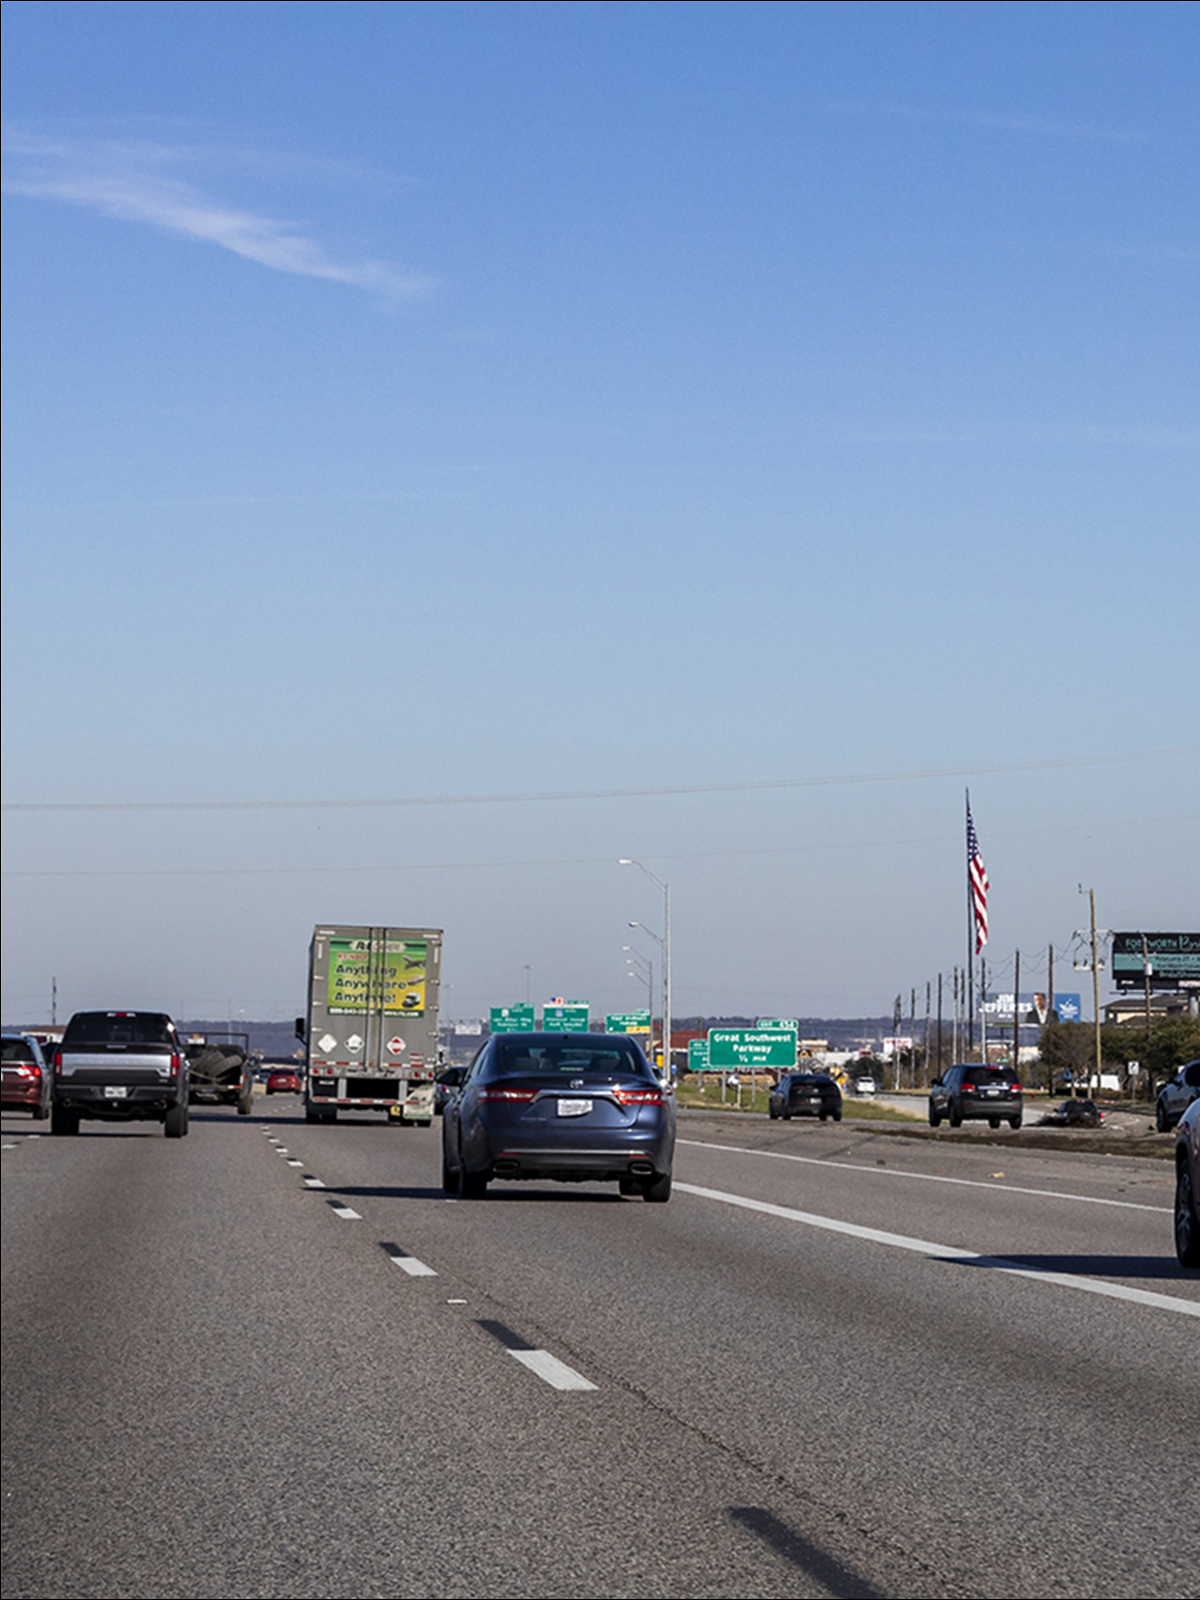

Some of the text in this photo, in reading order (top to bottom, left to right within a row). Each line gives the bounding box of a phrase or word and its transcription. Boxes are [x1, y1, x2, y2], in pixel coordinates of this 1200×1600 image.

[1125, 939, 1144, 948] FOR
[1148, 939, 1177, 948] WORTH
[996, 994, 1014, 1004] JIM
[714, 1033, 792, 1042] Great Southwest
[733, 1044, 772, 1055] Parkway
